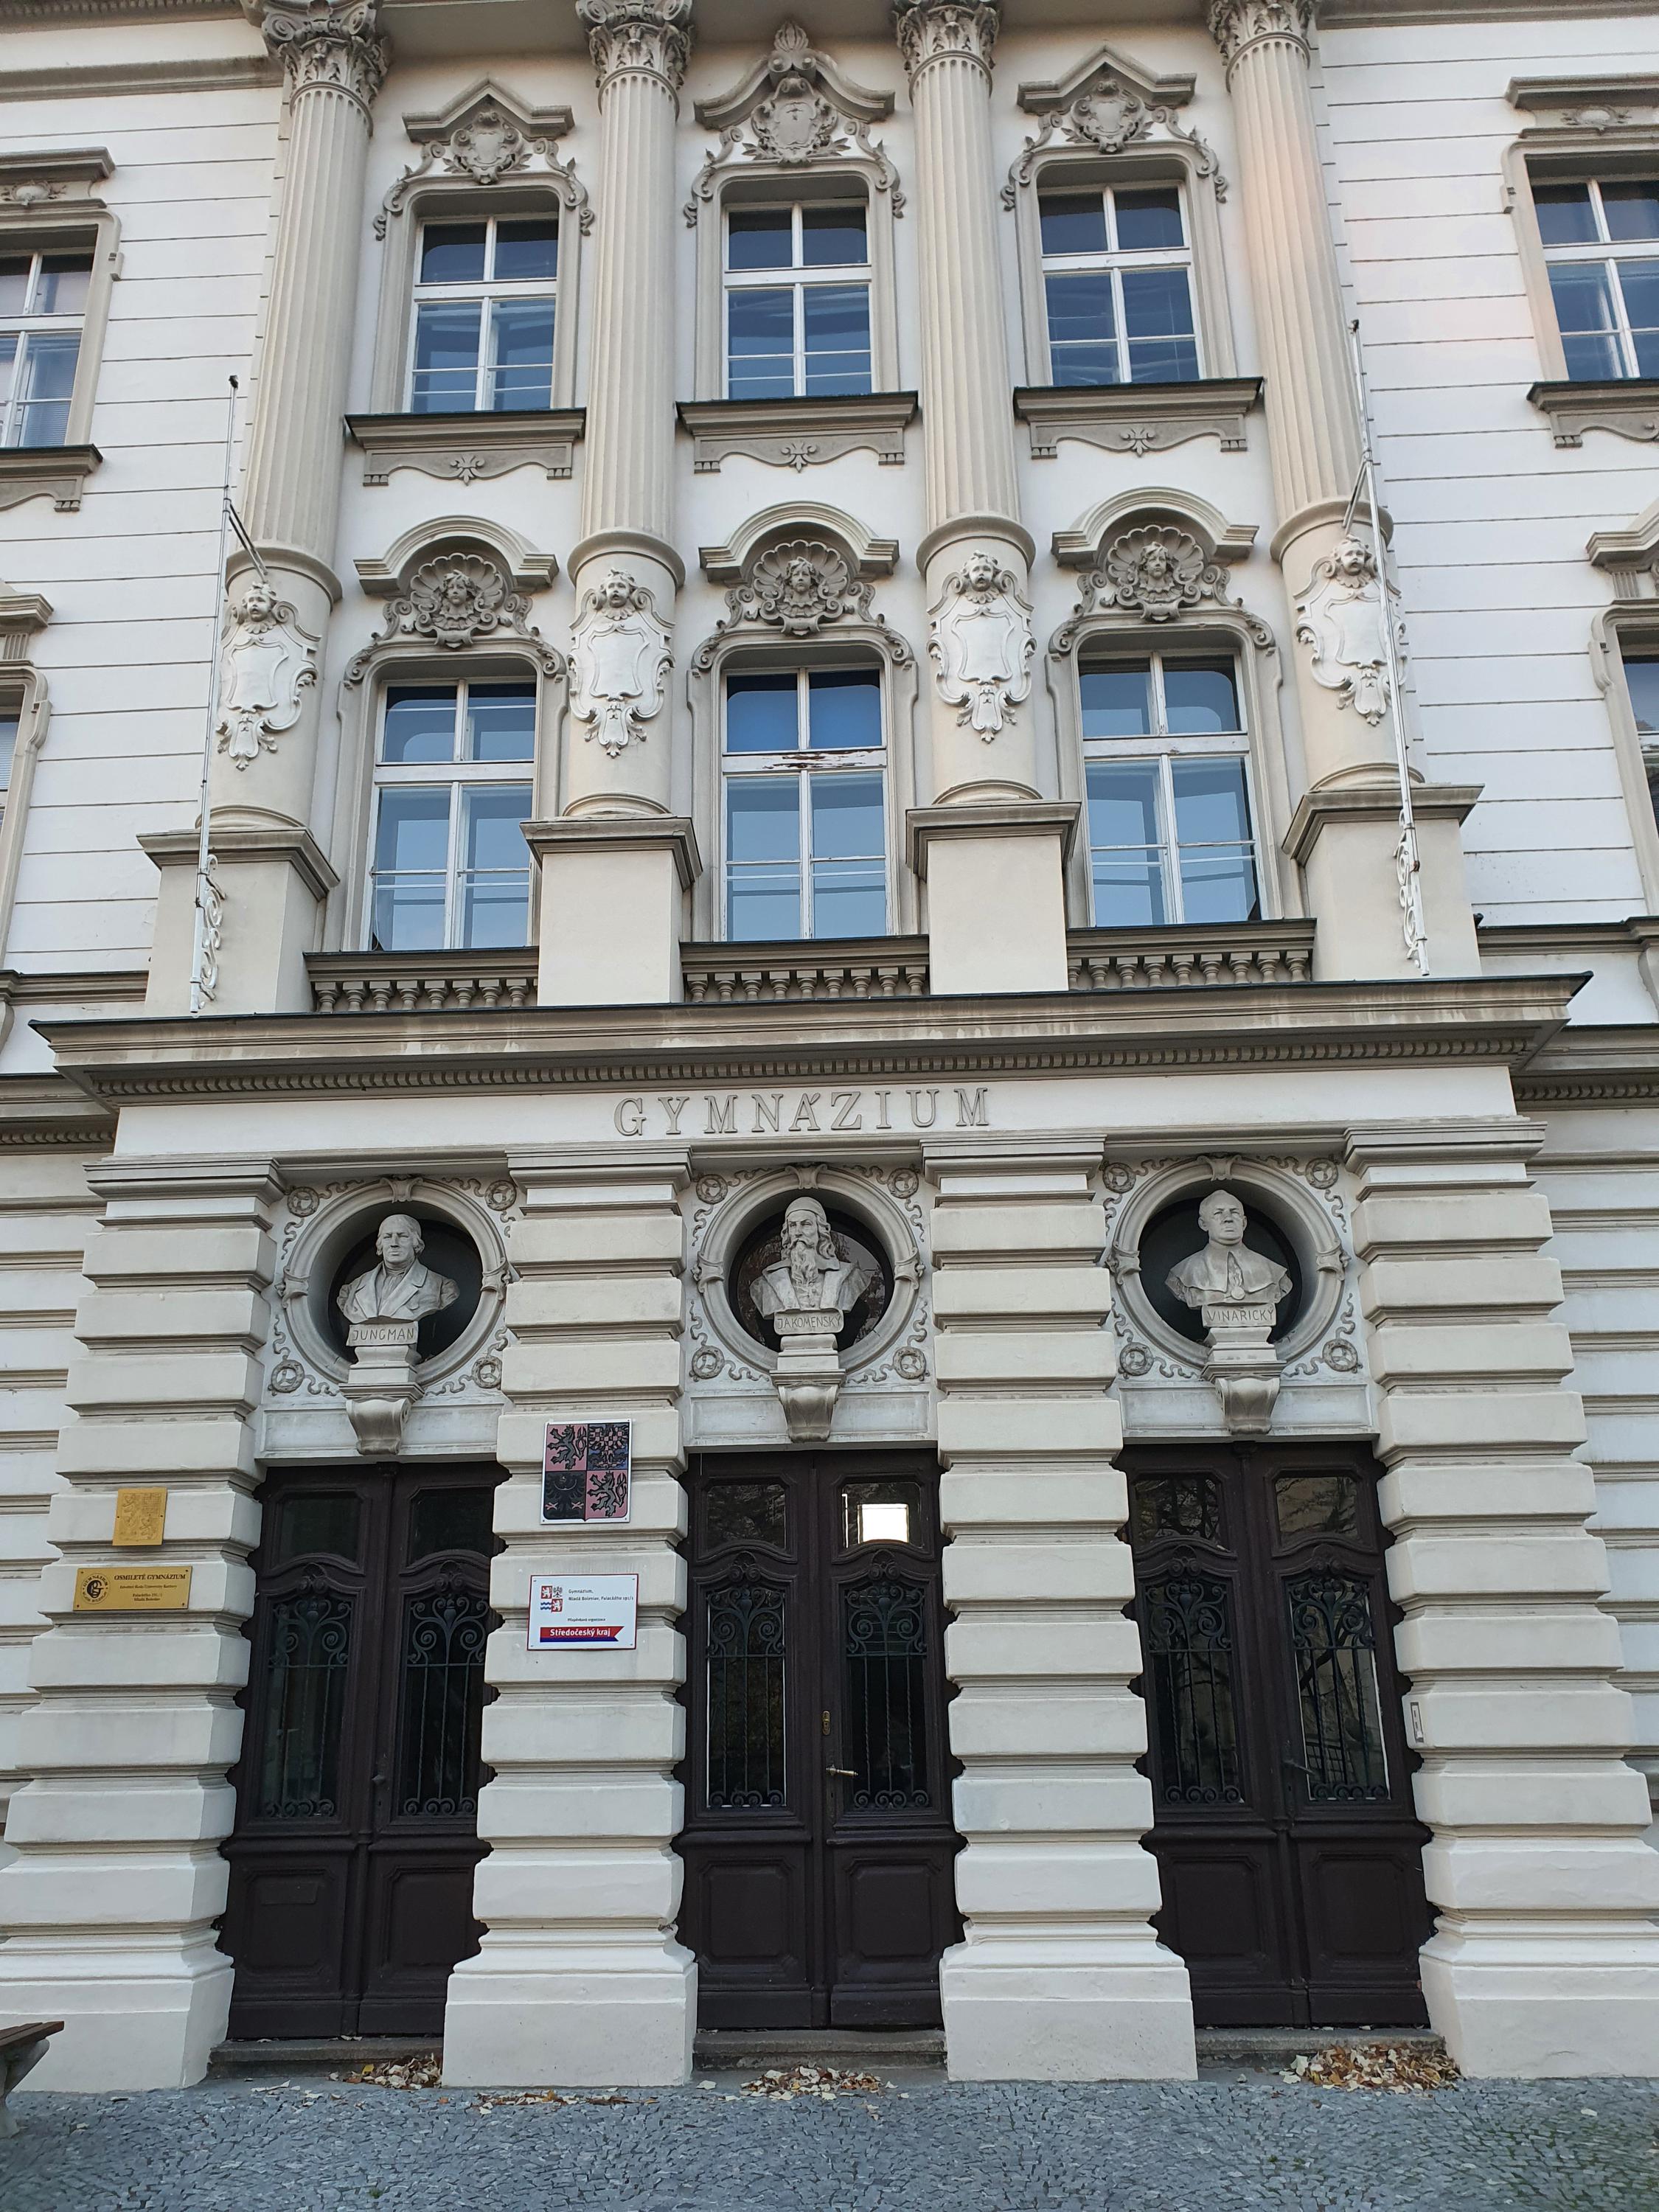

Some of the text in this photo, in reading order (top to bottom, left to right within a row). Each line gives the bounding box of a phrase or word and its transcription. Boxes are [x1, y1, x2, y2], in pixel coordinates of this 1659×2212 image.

[613, 1088, 989, 1136] GYMNÁZIUM
[352, 1328, 414, 1341] JUNGMAN
[550, 1628, 611, 1637] Středočeský kraj
